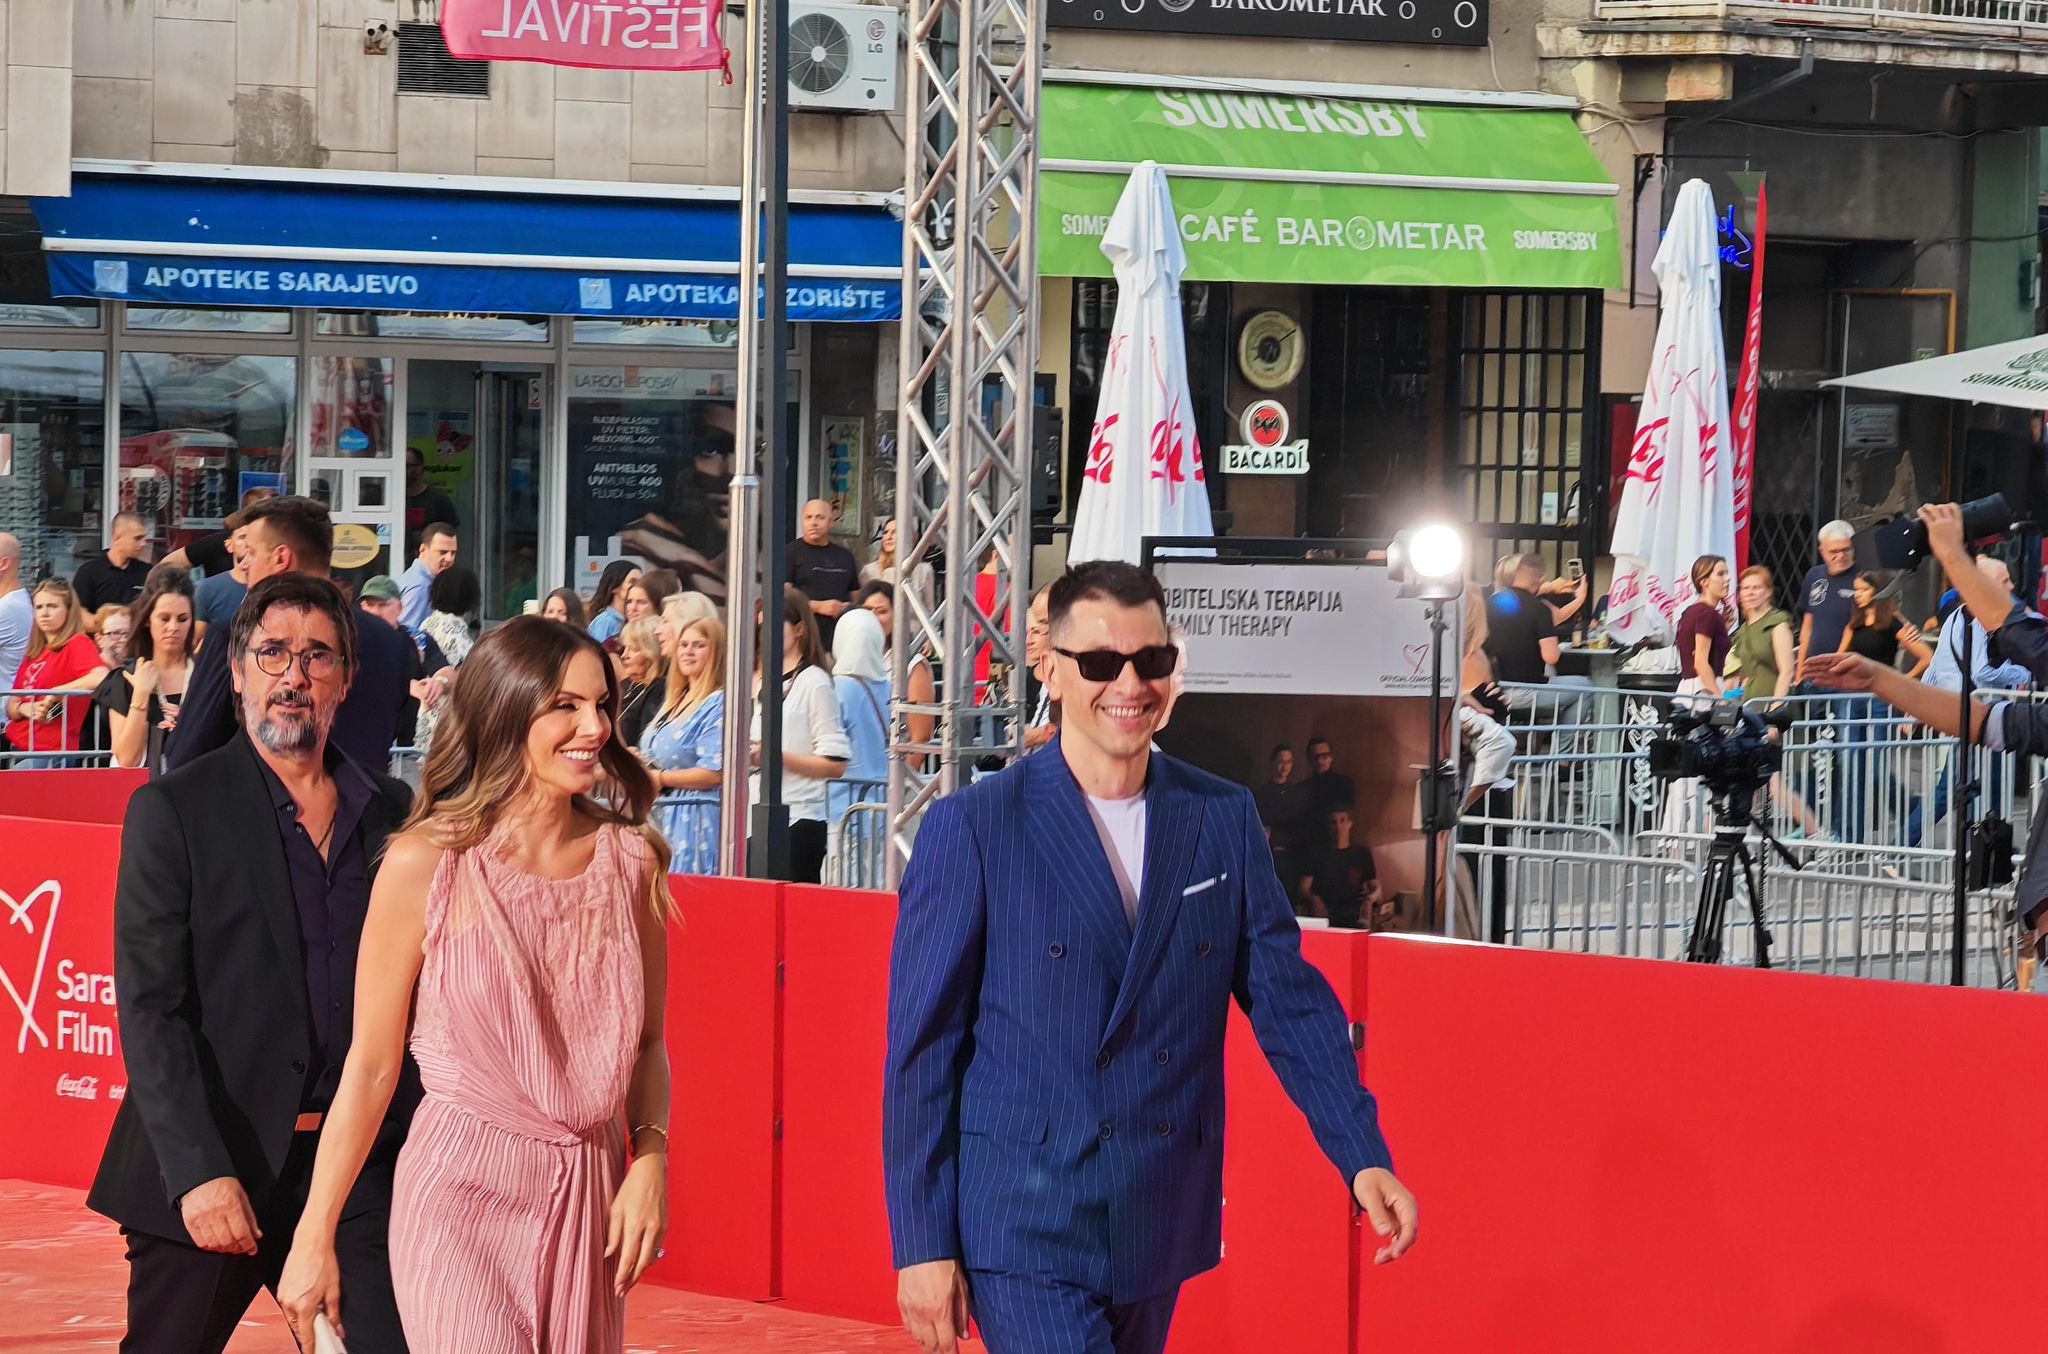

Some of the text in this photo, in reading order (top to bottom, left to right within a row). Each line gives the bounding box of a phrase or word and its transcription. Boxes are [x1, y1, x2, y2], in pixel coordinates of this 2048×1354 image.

[868, 43, 884, 53] LG
[1154, 88, 1427, 138] SOMERSBY
[1061, 213, 1109, 236] SOME
[1179, 208, 1487, 250] CAFÉ BAROMETAR
[1512, 229, 1599, 251] SOMERSBY
[144, 266, 418, 295] APOTEKE SARAJEVO
[625, 283, 740, 305] APOTEKA
[1229, 444, 1303, 469] BACARDÍ
[1264, 590, 1343, 613] TERAPIJA
[1219, 614, 1293, 637] THERAPY
[56, 959, 117, 1005] Sara
[57, 1010, 113, 1056] Film
